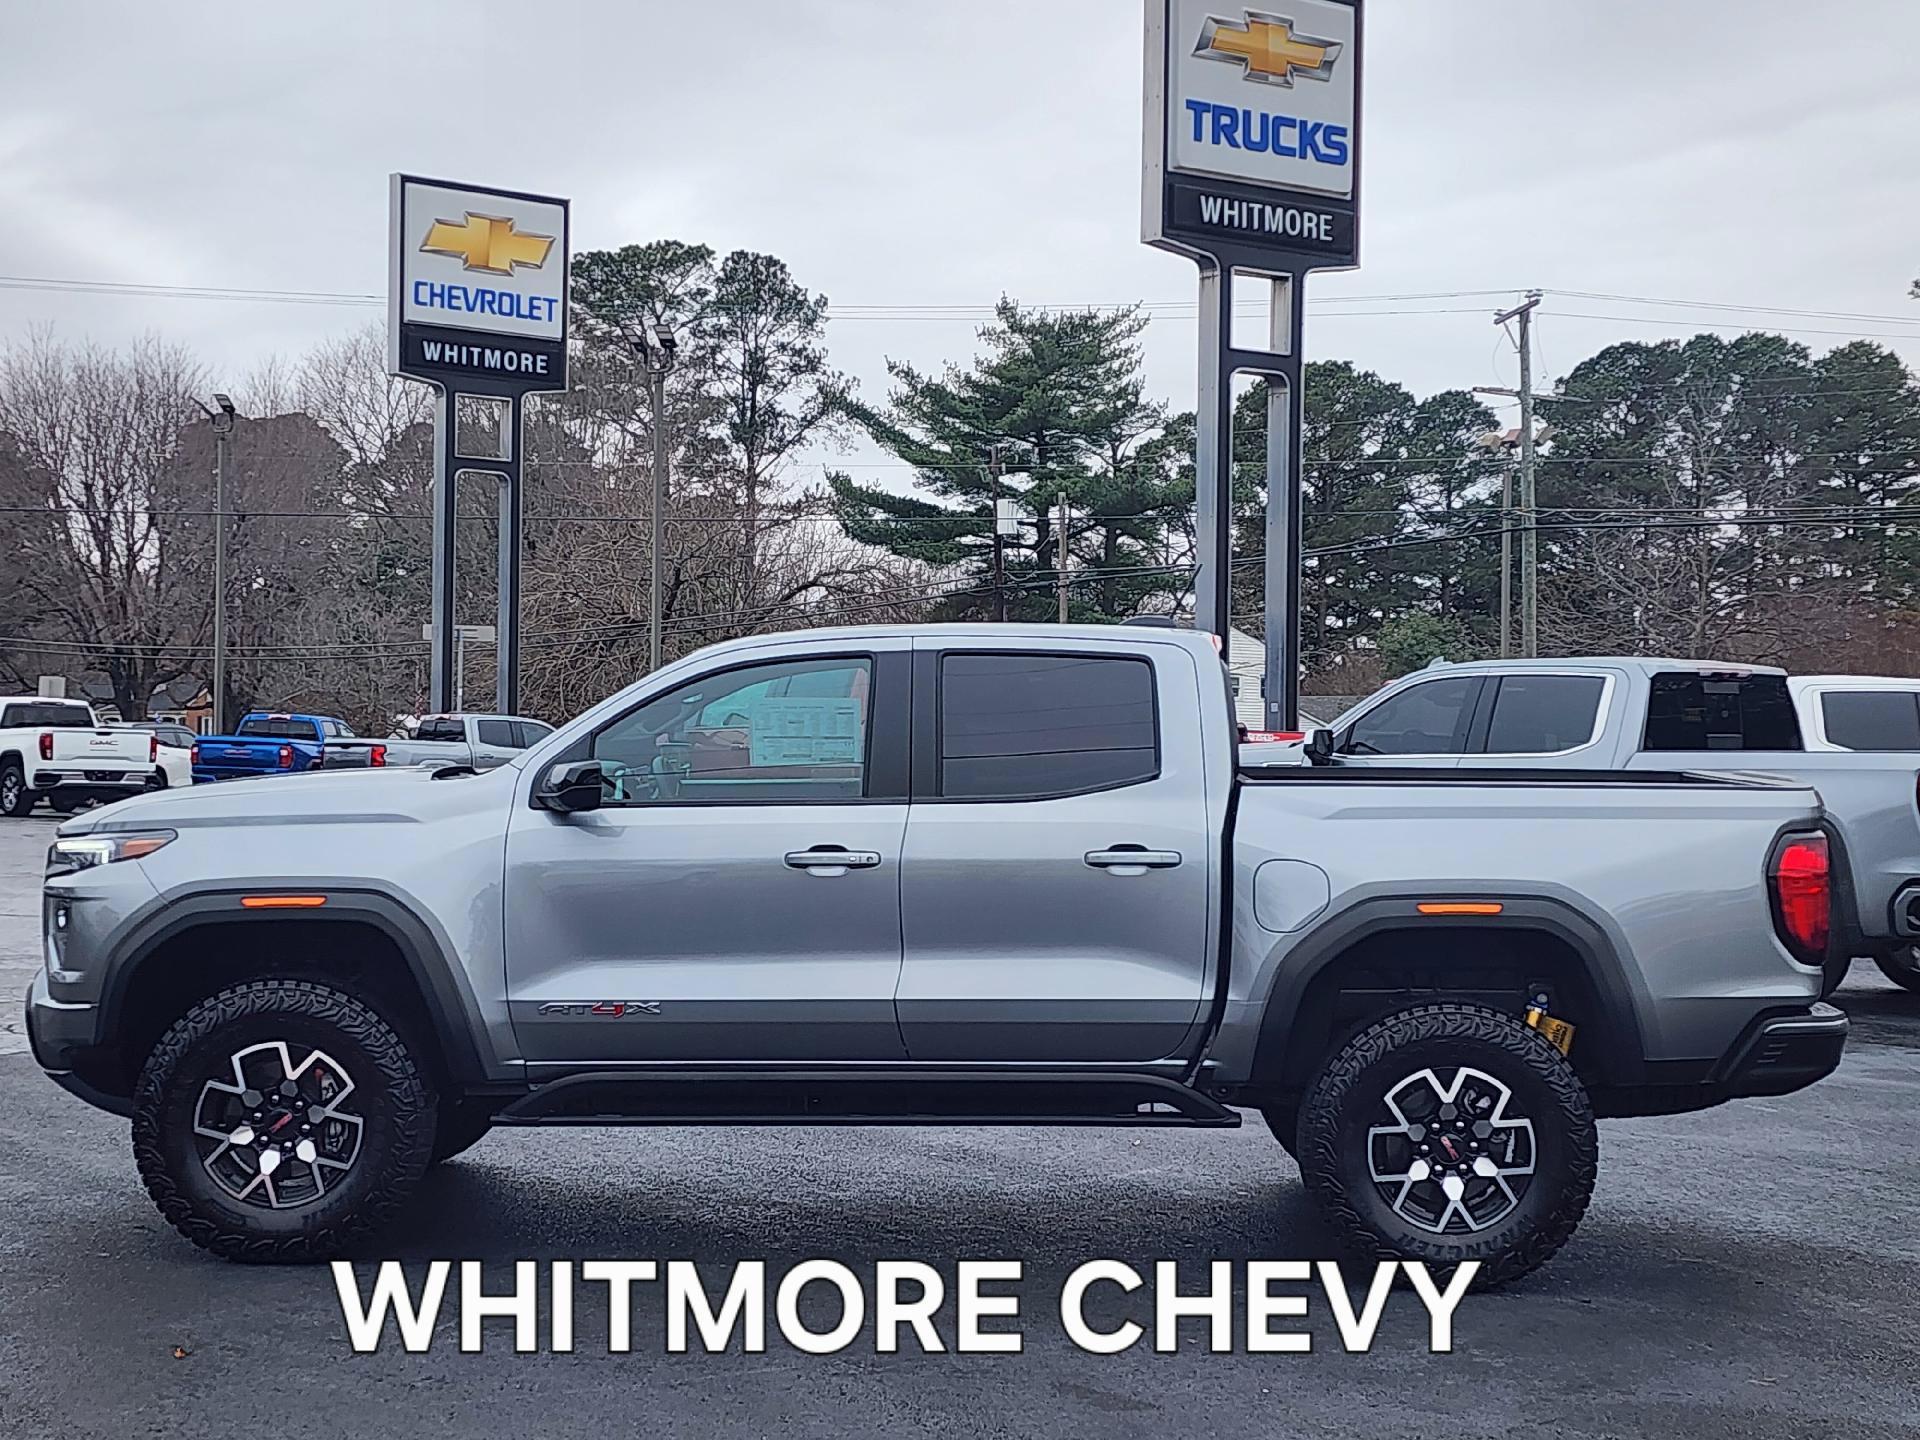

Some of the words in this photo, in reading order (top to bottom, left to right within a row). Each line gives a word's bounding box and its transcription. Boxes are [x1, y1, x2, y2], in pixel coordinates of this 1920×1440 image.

[1185, 99, 1348, 166] TRUCKS
[1199, 195, 1334, 241] WHITMORE
[414, 280, 559, 322] CHEVROLET
[422, 340, 549, 374] WHITMORE
[538, 1001, 661, 1019] AT4X
